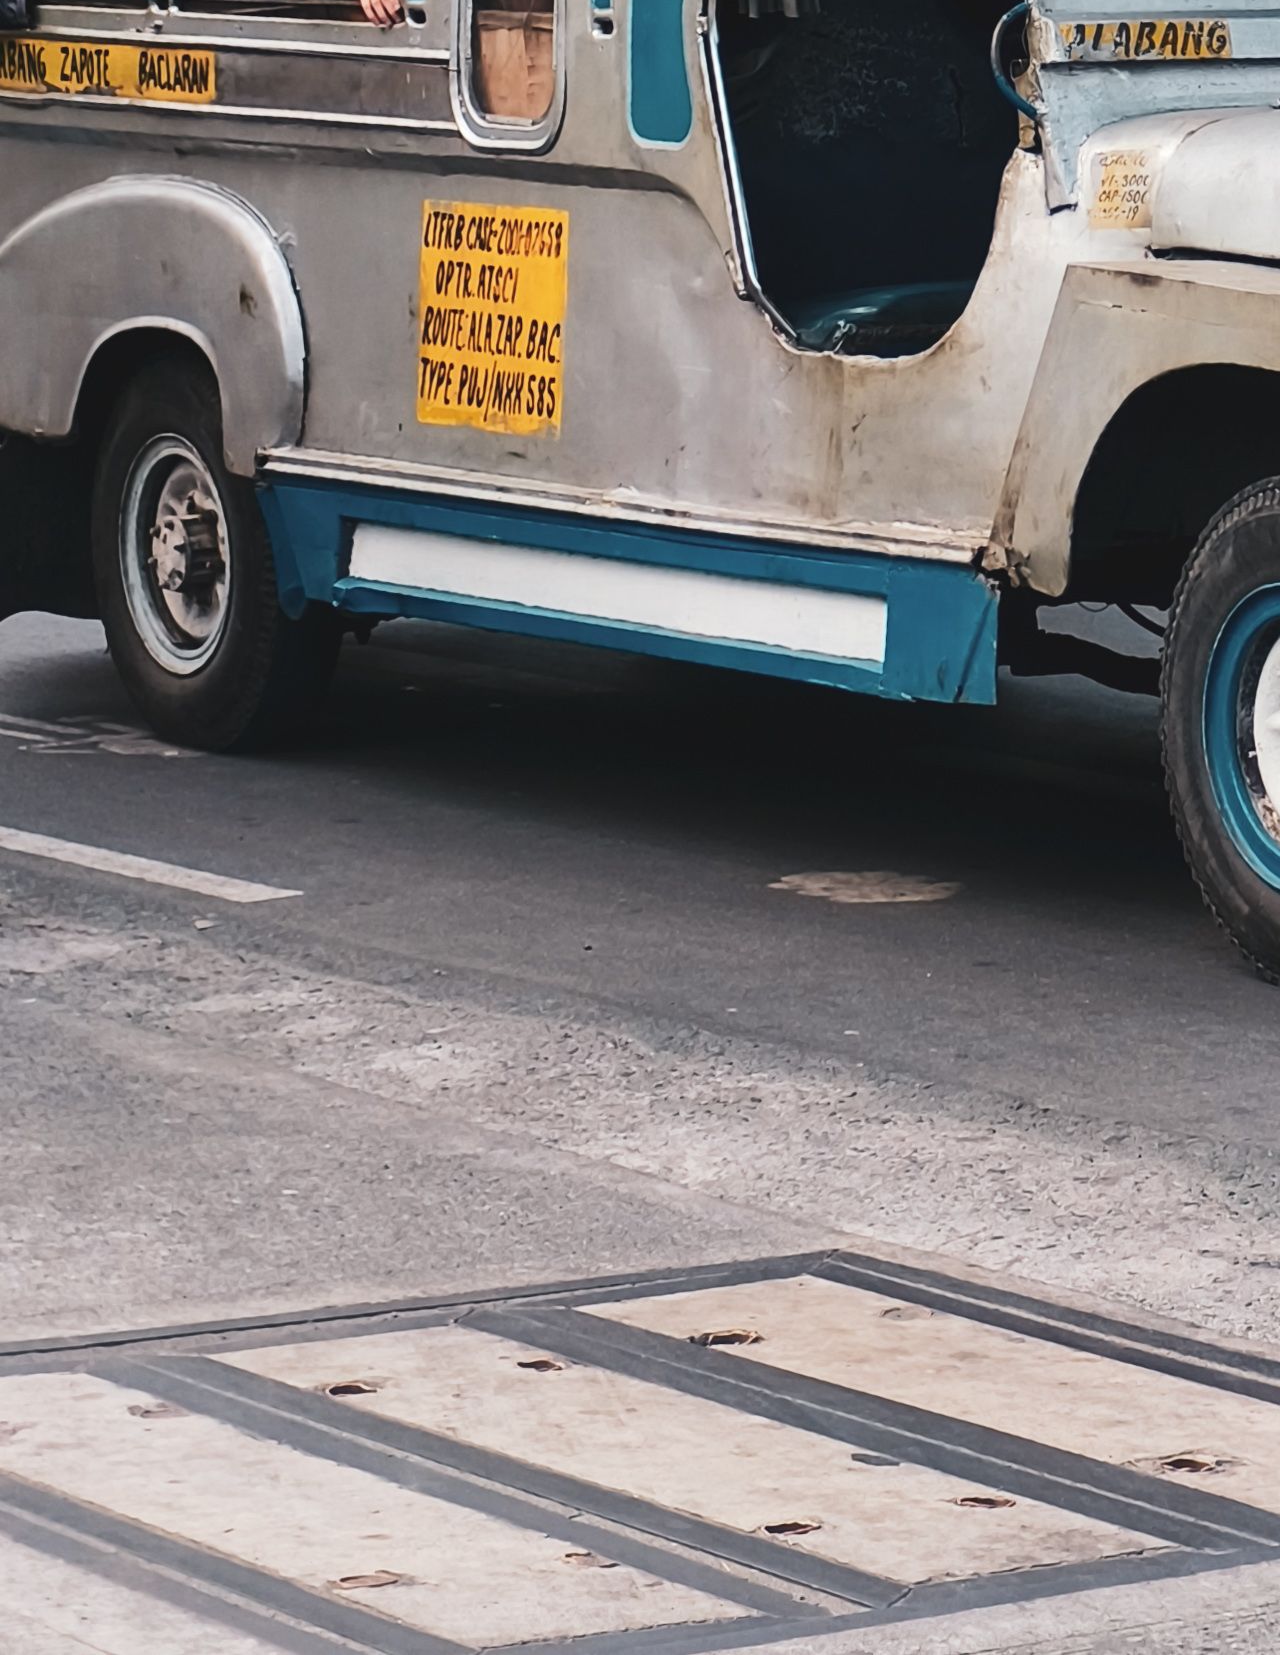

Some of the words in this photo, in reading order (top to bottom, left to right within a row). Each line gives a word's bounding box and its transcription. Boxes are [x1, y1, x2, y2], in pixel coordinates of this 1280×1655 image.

[59, 46, 110, 86] ZAPOTE
[138, 50, 210, 94] BACLARAN
[419, 357, 454, 406] TYPE
[526, 374, 556, 420] 585
